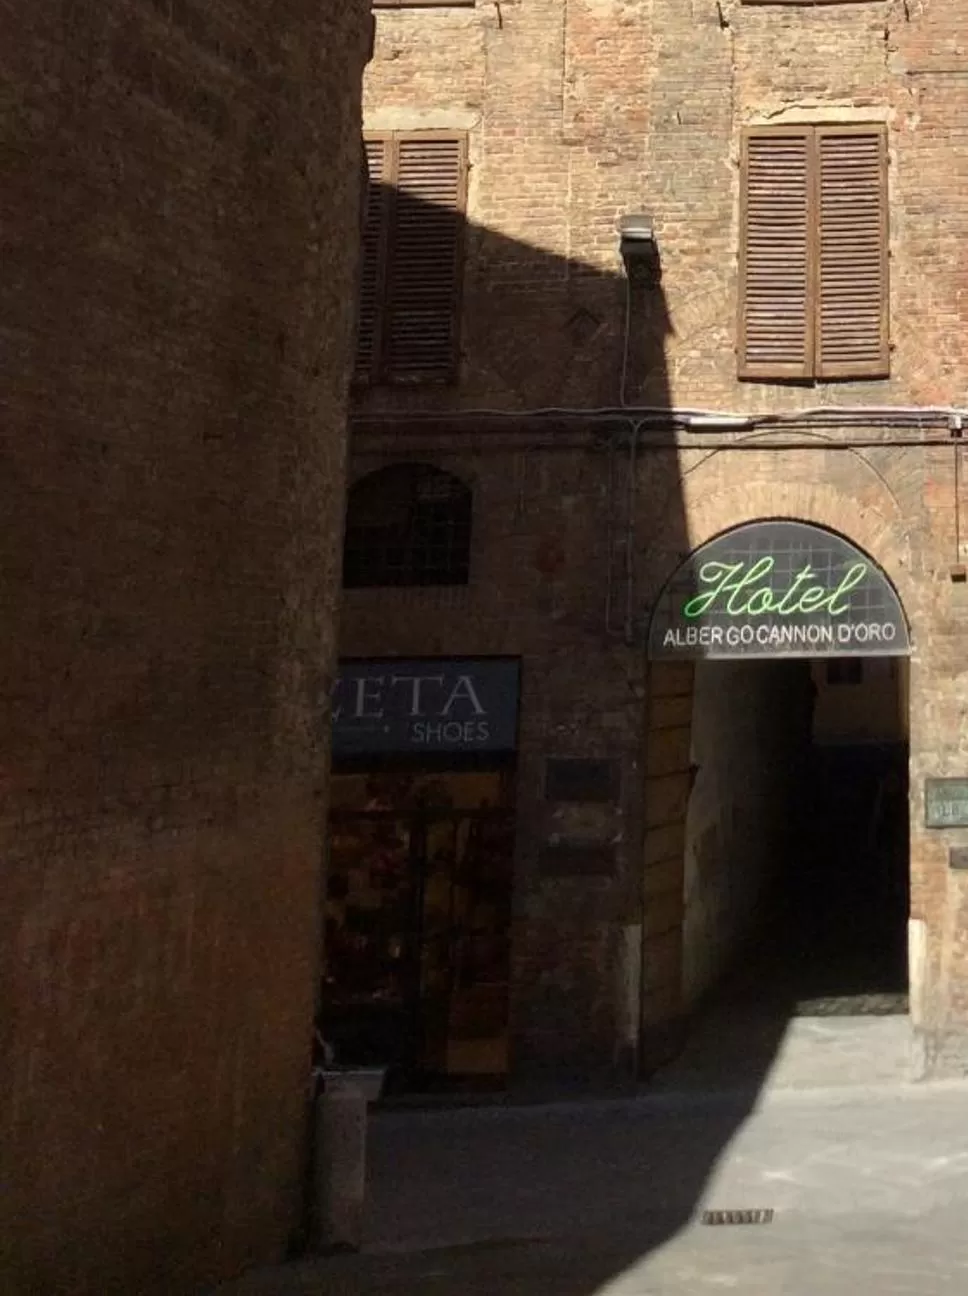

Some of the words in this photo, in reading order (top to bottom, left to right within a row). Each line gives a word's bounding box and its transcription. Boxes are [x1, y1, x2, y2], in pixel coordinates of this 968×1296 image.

[684, 556, 867, 616] Hotel
[663, 625, 753, 646] ALBERGO
[756, 624, 832, 645] CANNON
[838, 622, 896, 643] D'ORO
[412, 722, 489, 744] SHOES
